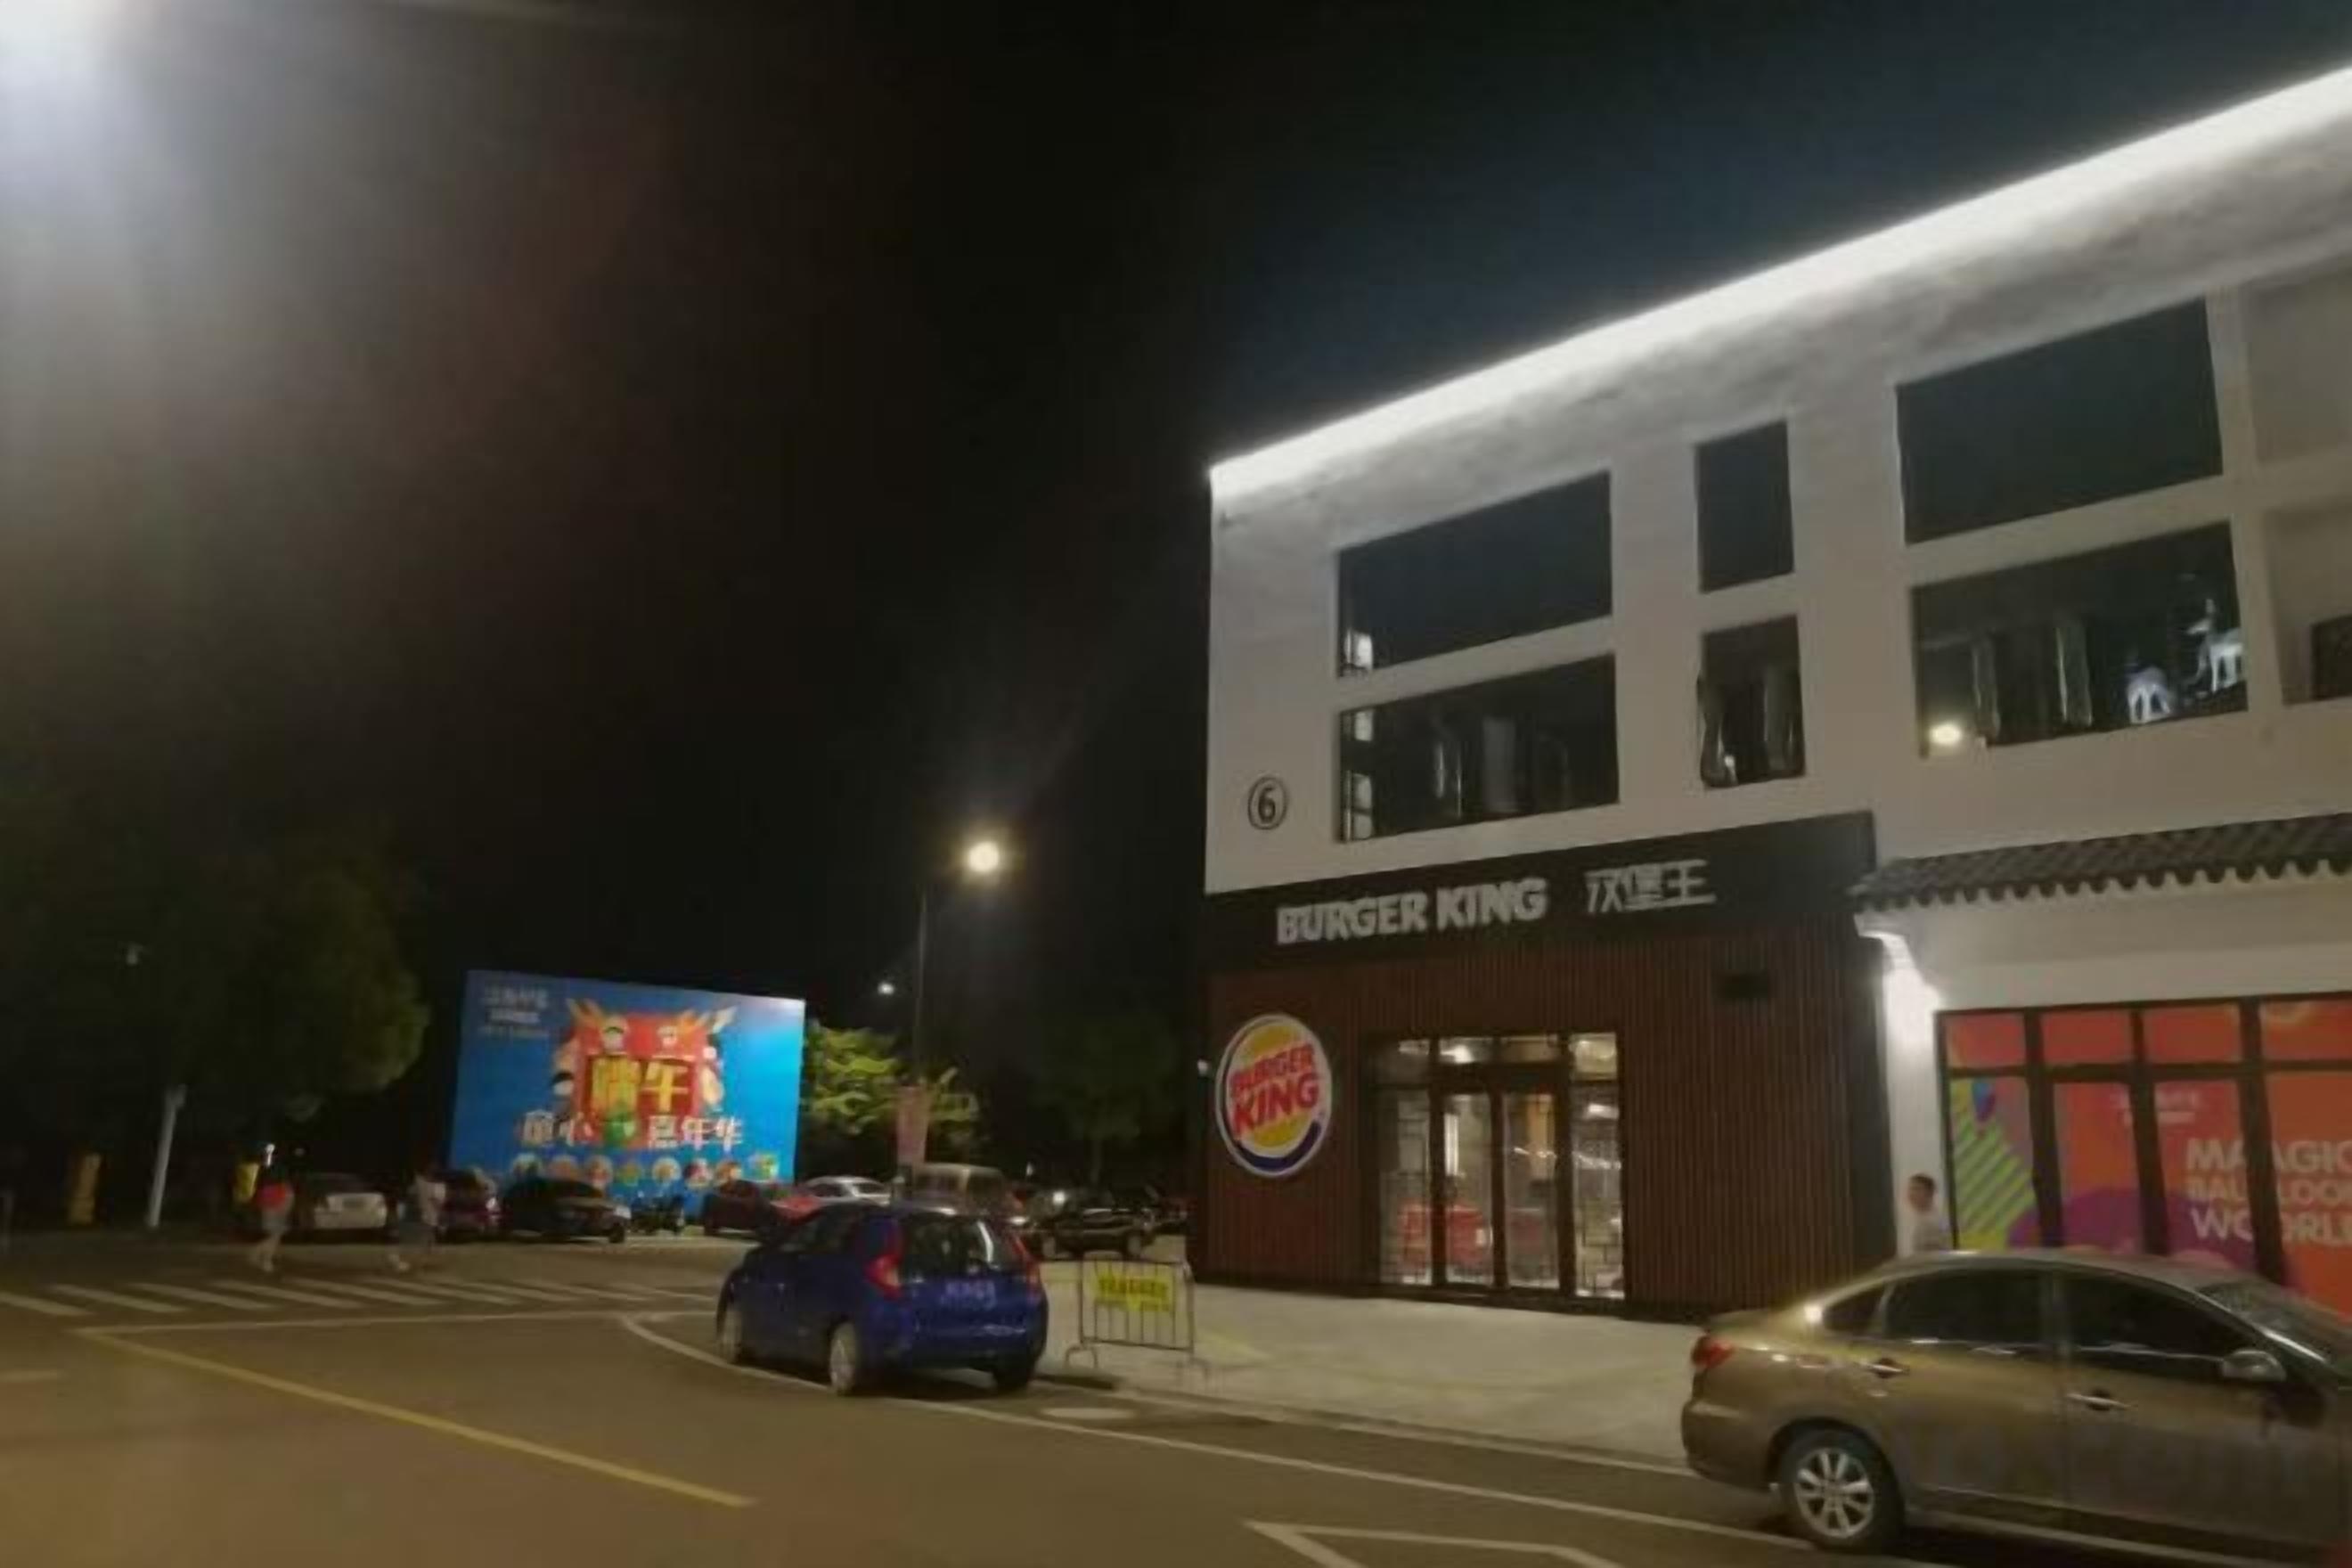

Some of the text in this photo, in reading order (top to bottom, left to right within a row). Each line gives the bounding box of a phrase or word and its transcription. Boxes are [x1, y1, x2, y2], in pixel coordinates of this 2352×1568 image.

[1277, 878, 1548, 944] BURGER KING
[1583, 859, 1718, 914] 汉堡王
[1231, 1042, 1315, 1097] BURGER
[1233, 1072, 1319, 1137] KING
